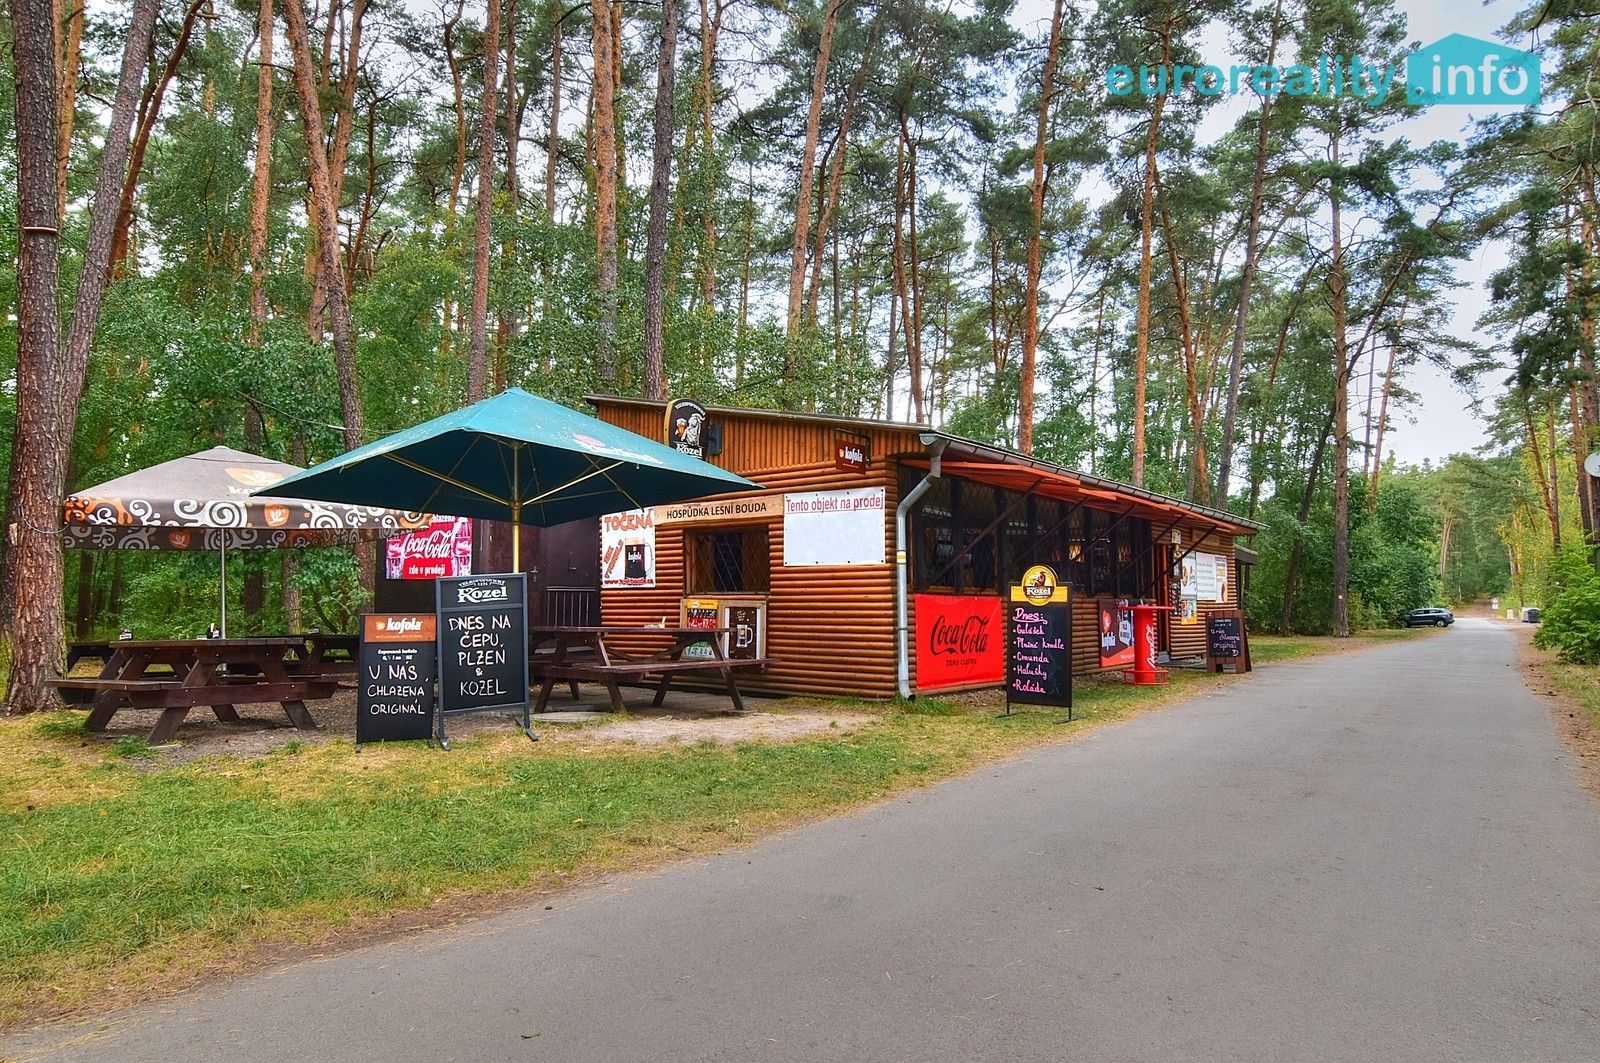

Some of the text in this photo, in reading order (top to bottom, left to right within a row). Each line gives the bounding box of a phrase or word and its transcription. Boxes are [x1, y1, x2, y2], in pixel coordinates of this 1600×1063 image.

[844, 446, 863, 464] kofola
[666, 502, 767, 519] HOSPŮDKA LESNÍ BOUDA
[786, 493, 883, 513] Tento objekt na prodej
[604, 507, 654, 532] TOČENÁ
[408, 566, 419, 574] zde
[425, 564, 446, 576] prodeji
[457, 586, 508, 603] Kozel
[1026, 587, 1051, 597] Kozel
[386, 617, 423, 634] kofola
[448, 614, 511, 631] DNES NA
[460, 631, 499, 648] ČEPU
[931, 615, 989, 656] Coca-Cola
[368, 660, 418, 680] U NÁS
[475, 667, 483, 676] &
[367, 677, 429, 697] CHLAZENÁ
[460, 678, 508, 696] KOZEL
[370, 698, 426, 715] ORIGINÁL
